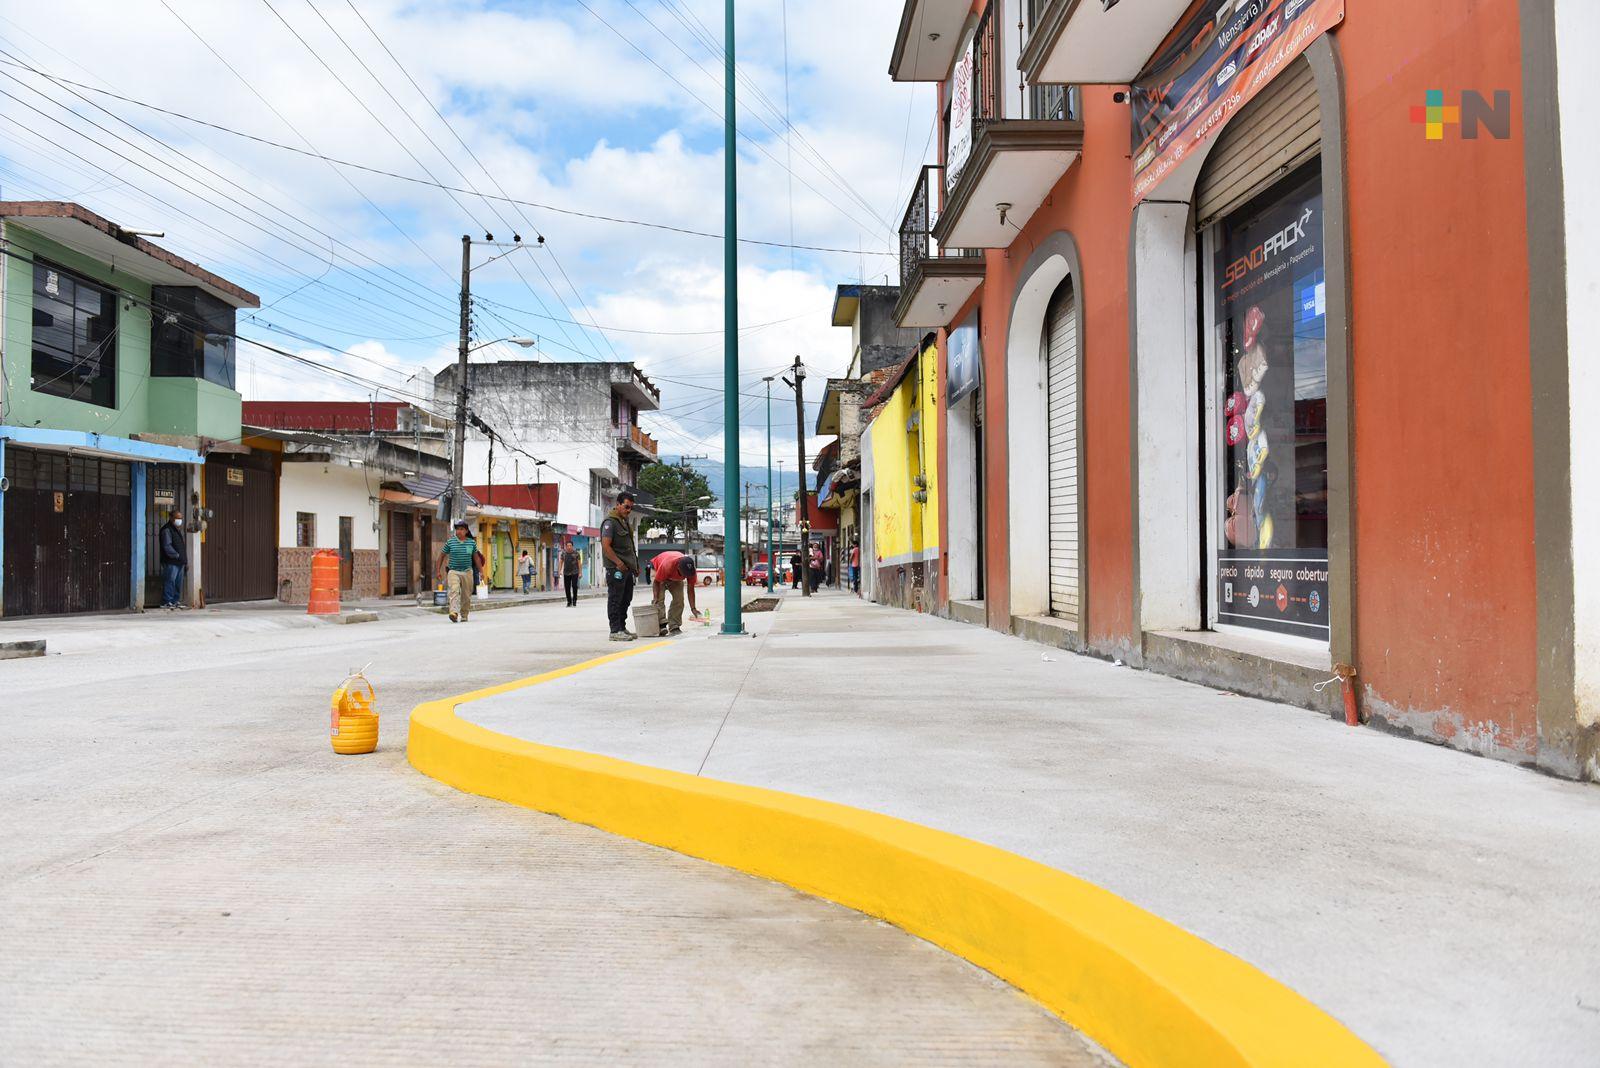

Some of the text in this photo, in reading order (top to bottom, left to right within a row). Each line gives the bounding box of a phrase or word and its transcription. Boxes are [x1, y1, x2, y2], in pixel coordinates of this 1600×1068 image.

[1304, 299, 1315, 312] VISA
[1220, 565, 1238, 579] precio
[1244, 565, 1265, 581] rápido
[1269, 568, 1293, 582] seguro
